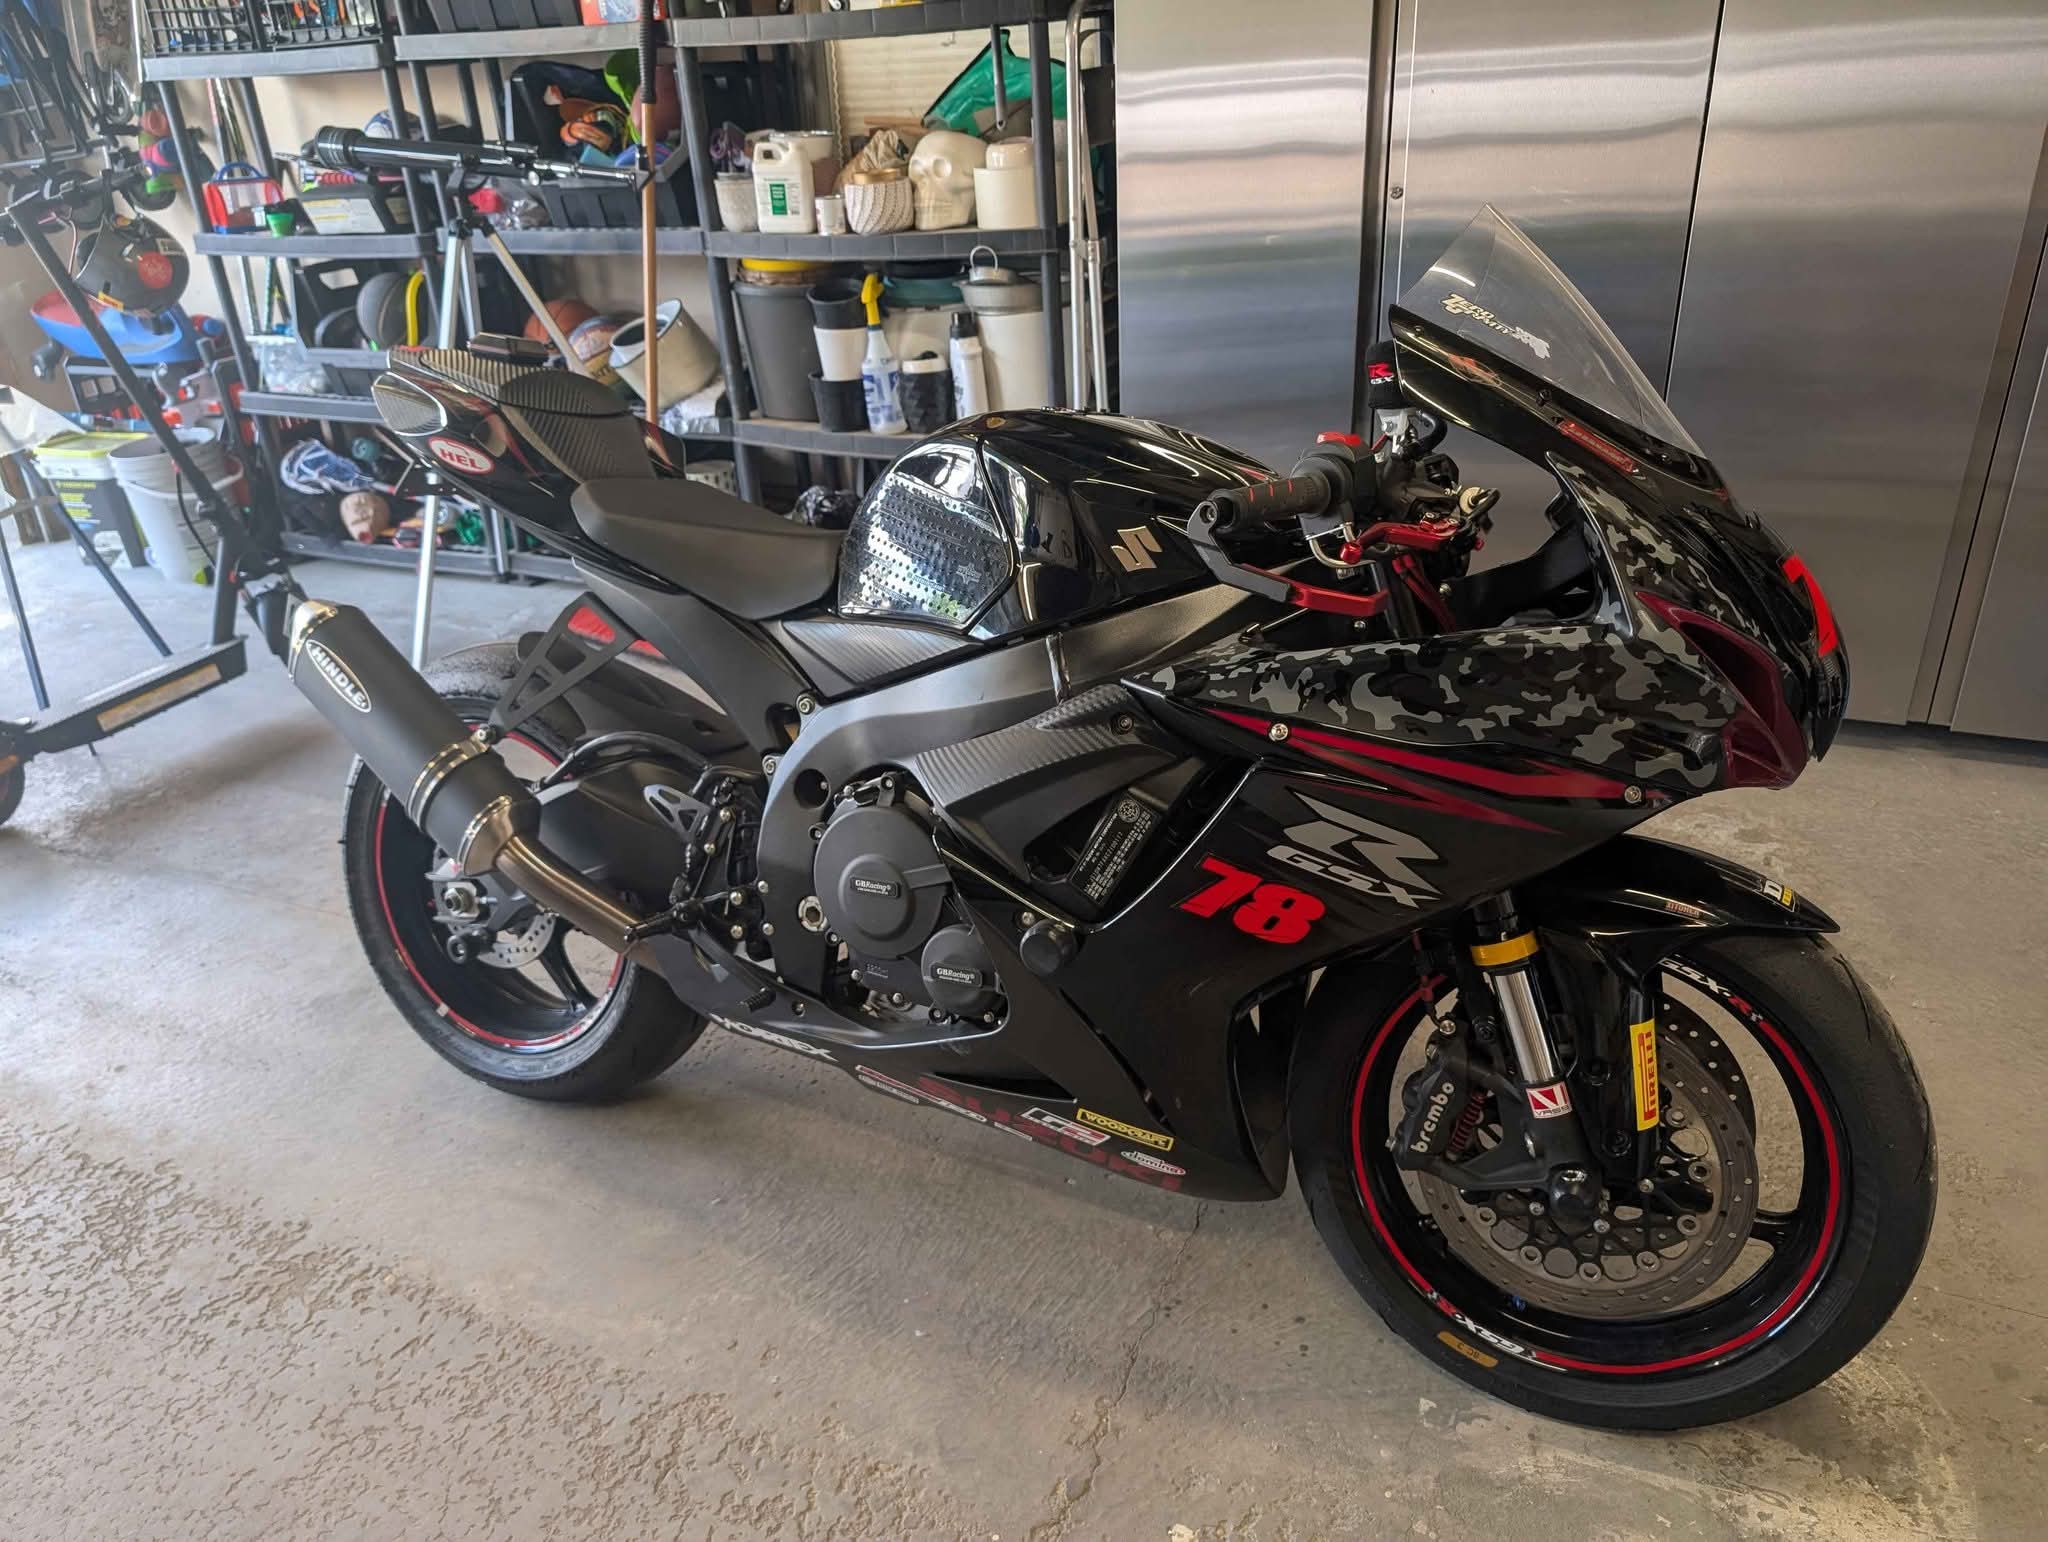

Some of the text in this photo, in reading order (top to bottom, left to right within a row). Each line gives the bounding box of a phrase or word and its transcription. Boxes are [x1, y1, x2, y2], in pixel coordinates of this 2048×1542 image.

[1441, 293, 1495, 319] ZERO
[1445, 305, 1510, 334] GRAVITY
[440, 448, 484, 470] HEL
[1266, 845, 1441, 909] GSX
[1179, 855, 1326, 944] 78
[1637, 1031, 1657, 1121] PIRELLI
[1085, 1111, 1169, 1148] WOODCRAFT
[1410, 1082, 1455, 1153] brembo
[1126, 1150, 1183, 1174] domino
